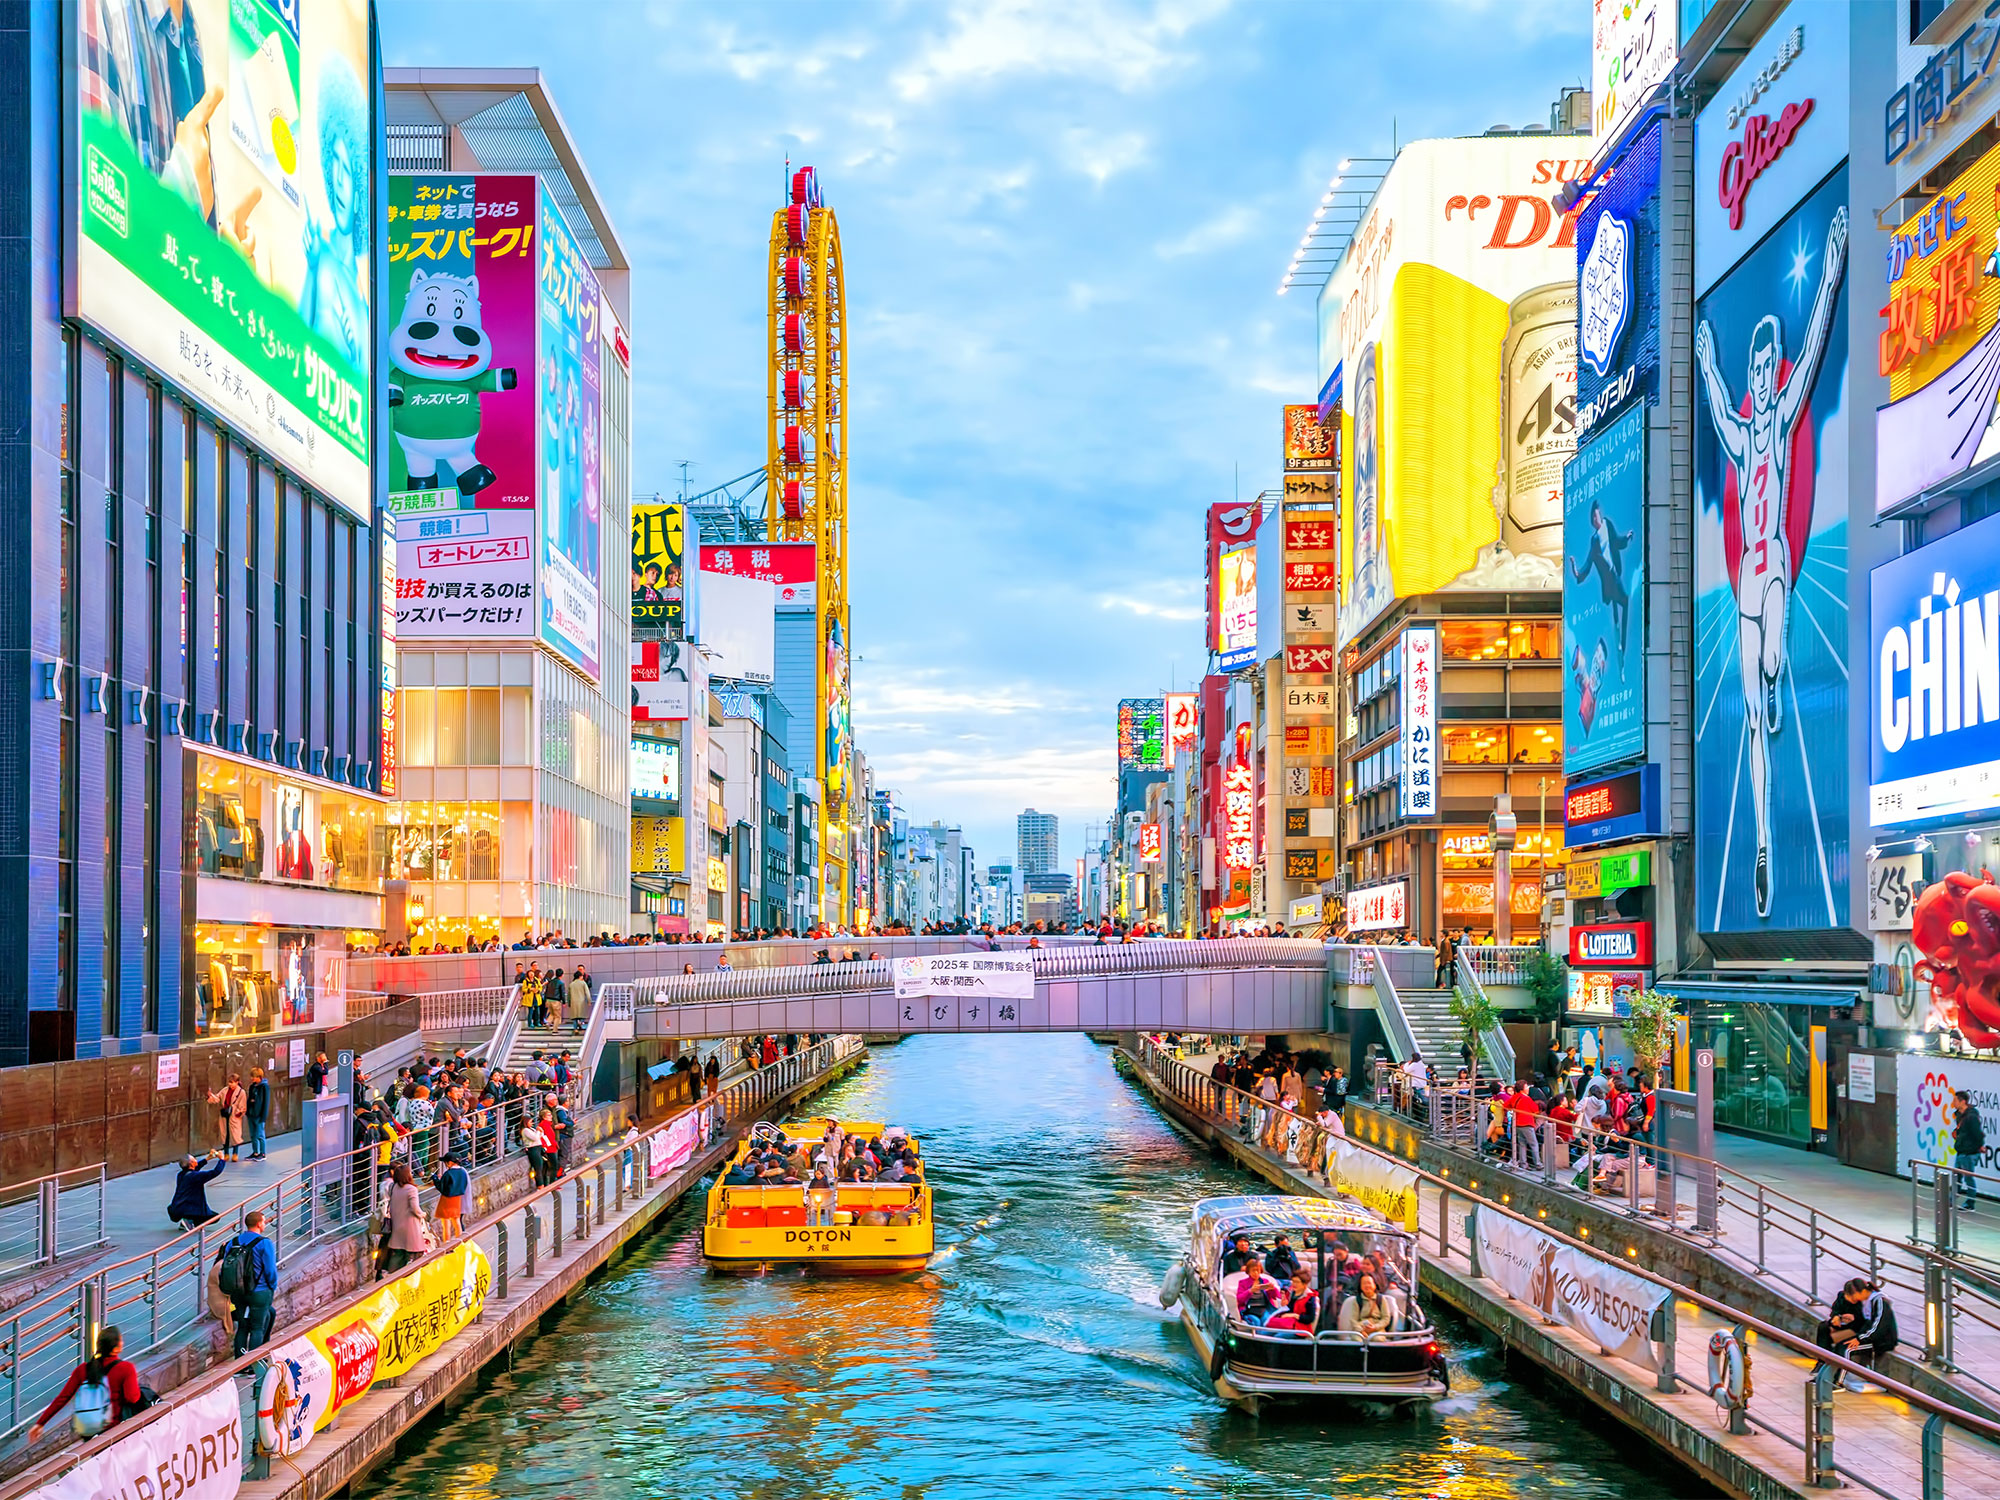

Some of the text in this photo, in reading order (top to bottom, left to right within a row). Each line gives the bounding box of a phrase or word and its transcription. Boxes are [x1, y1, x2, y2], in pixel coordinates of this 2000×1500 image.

[1623, 4, 1657, 83] ピップ
[1727, 24, 1805, 130] おいしさと健康
[1719, 98, 1817, 231] Glico
[415, 183, 477, 201] ネットで
[388, 225, 534, 262] ッズパーク!
[1886, 191, 1968, 284] かぜに
[1879, 233, 1978, 377] 改源
[1532, 346, 1556, 372] ASAHI
[178, 329, 260, 416] 貼るを、未来へ。
[304, 343, 366, 445] サロンパス
[411, 393, 470, 406] オッズパーク!
[1574, 364, 1636, 437] 雪印メグミルク
[1289, 458, 1301, 468] 9F
[1286, 481, 1334, 495] ドウトン
[1753, 454, 1770, 577] グリコ
[419, 518, 462, 537] 競輪!
[427, 540, 520, 564] オートレース!
[714, 549, 771, 569] 免税
[755, 571, 784, 582] Free
[1293, 564, 1314, 576] 相席
[1286, 575, 1333, 588] ダイニング
[396, 607, 523, 624] ッズパークだけ!
[1288, 690, 1330, 706] 白木屋
[1413, 658, 1430, 719] 本場の味
[1223, 764, 1253, 869] 大阪王将
[1288, 866, 1316, 877] ドンキー
[1289, 856, 1314, 867] びっくり
[1589, 933, 1633, 955] LOTTERIA
[930, 960, 1033, 972] 2025年 国際博覧会を
[930, 975, 985, 986] 大阪・関西へ
[903, 1004, 1016, 1022] えびす橋
[785, 1229, 852, 1243] DOTON
[807, 1243, 831, 1253] 大阪
[1551, 1268, 1591, 1311] MGM
[134, 1417, 240, 1500] RESORTS
